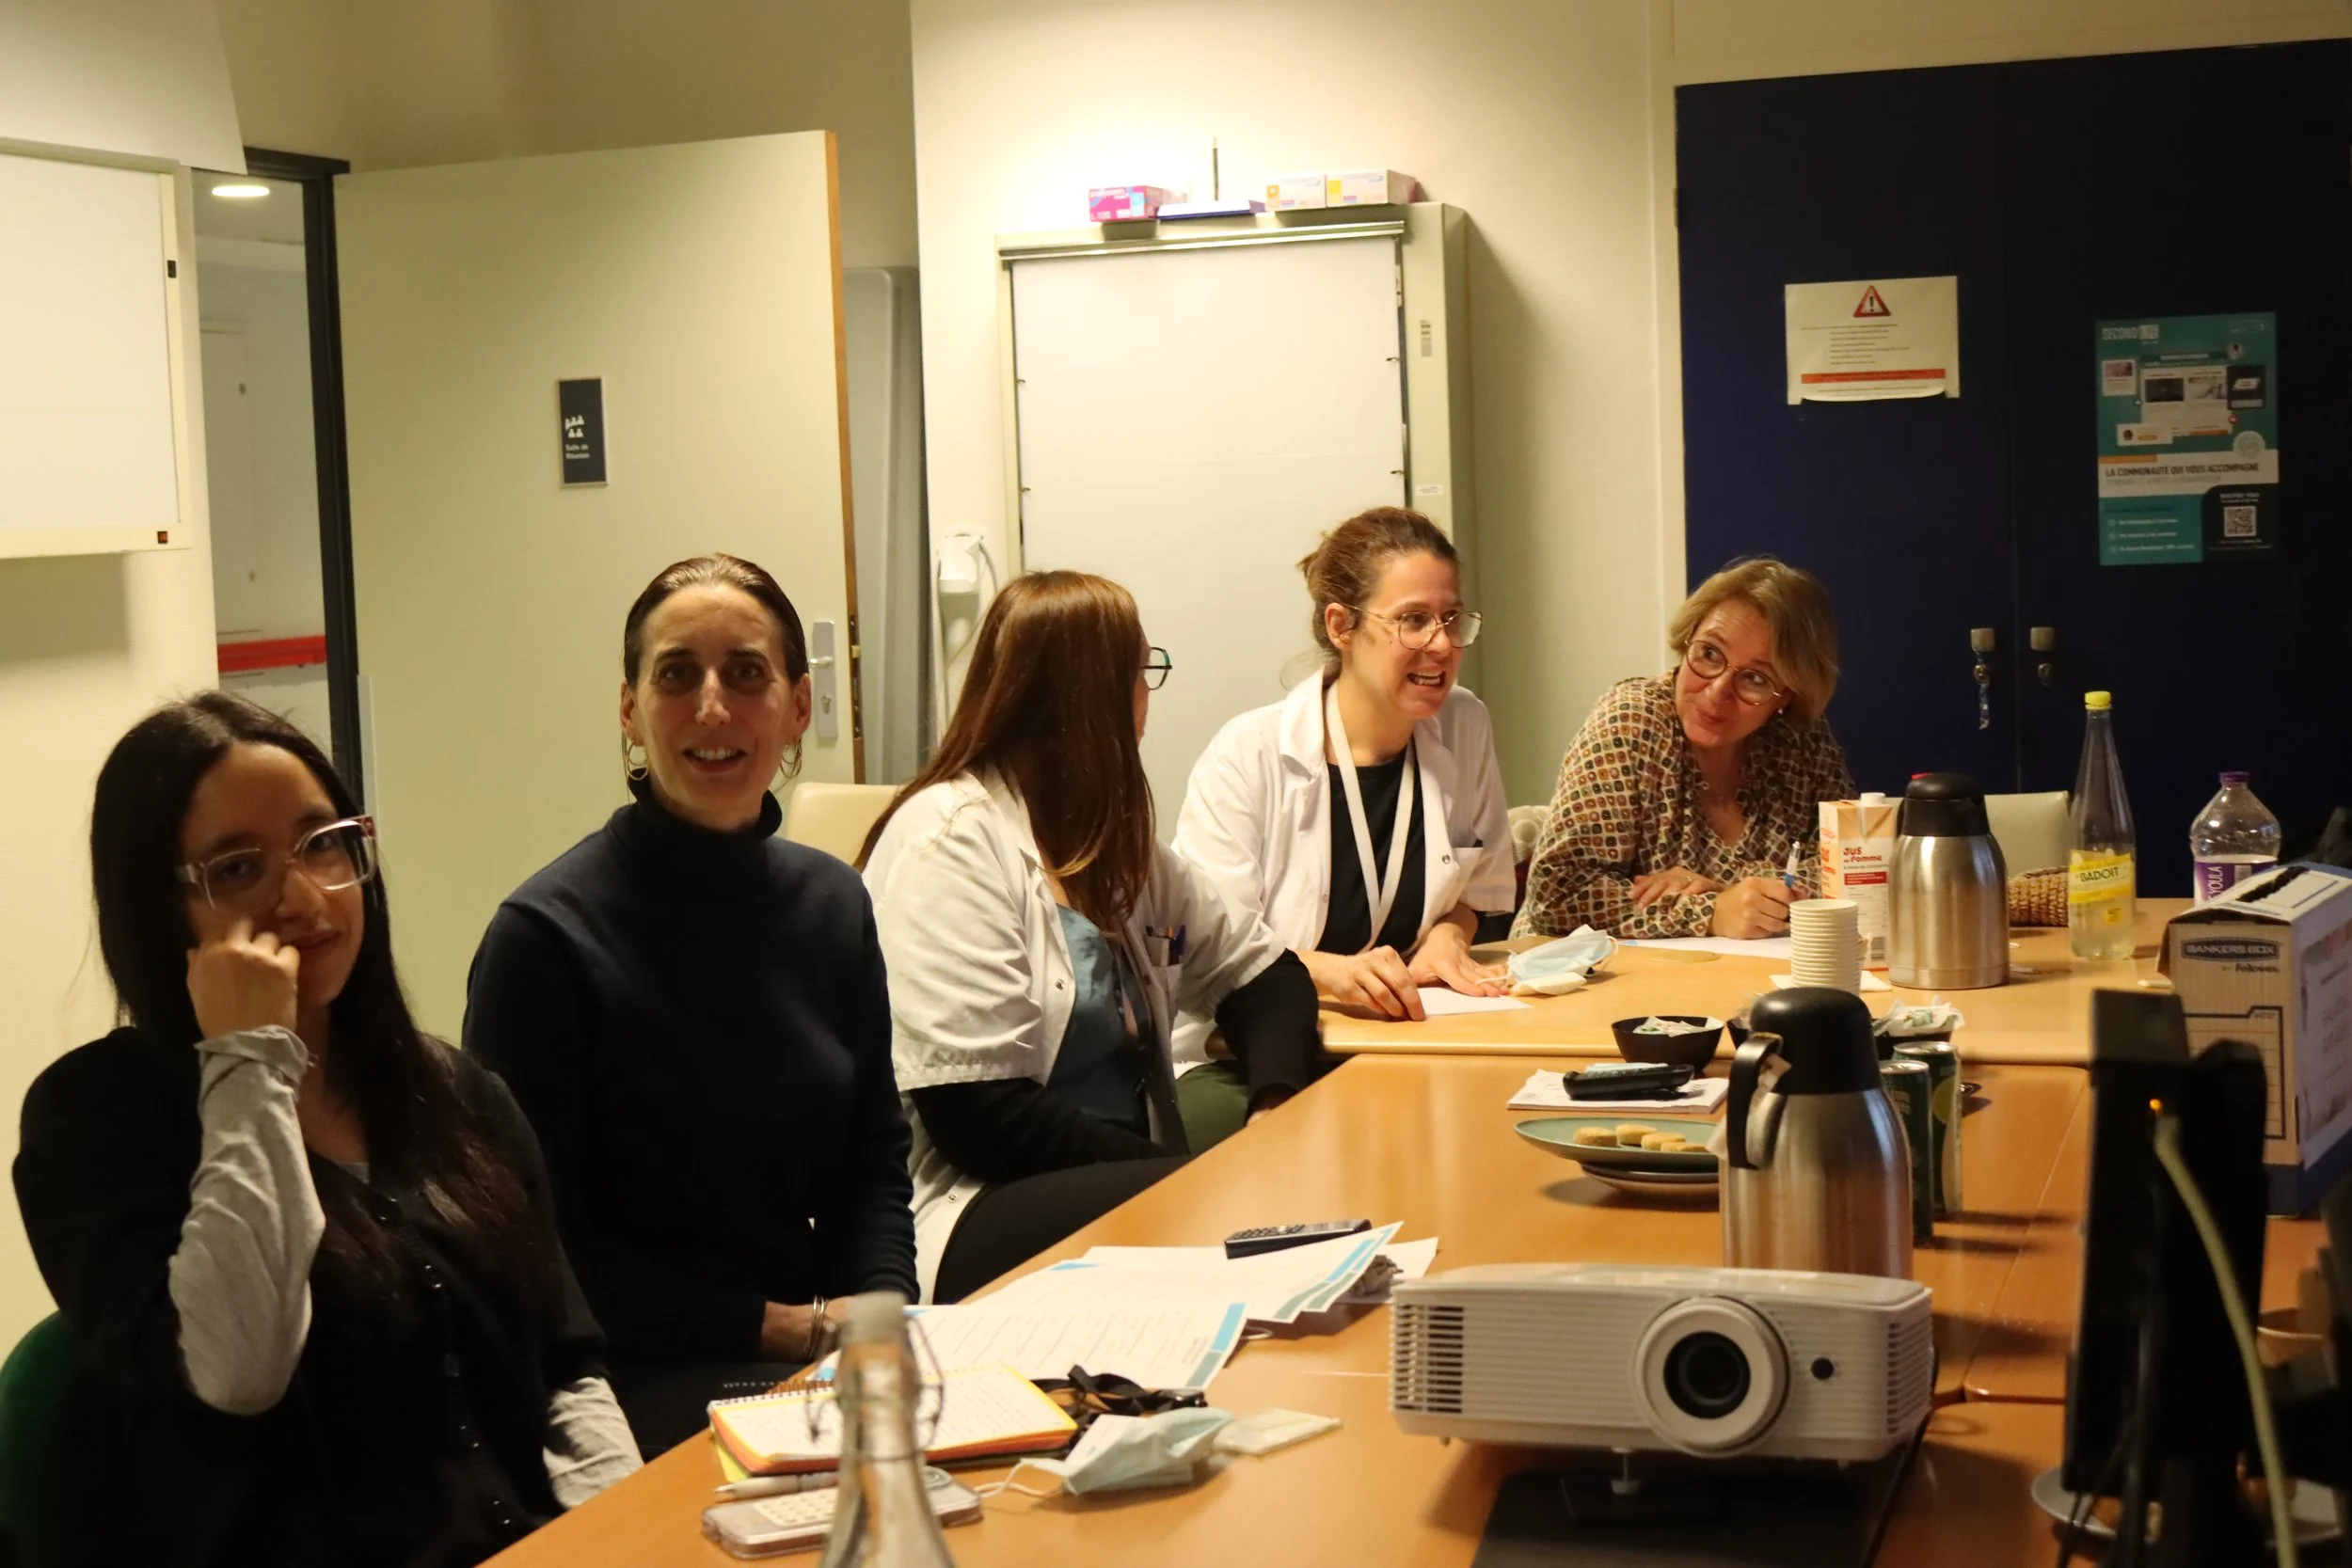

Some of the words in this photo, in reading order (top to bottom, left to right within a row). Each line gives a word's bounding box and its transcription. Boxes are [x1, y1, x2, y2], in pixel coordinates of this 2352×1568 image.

[2106, 467, 2117, 477] LA
[2185, 464, 2207, 474] VOUS
[2079, 866, 2120, 882] BADOIT
[2207, 866, 2223, 899] YOULA
[2185, 943, 2246, 954] BANKERS
[2248, 943, 2275, 954] BOX
